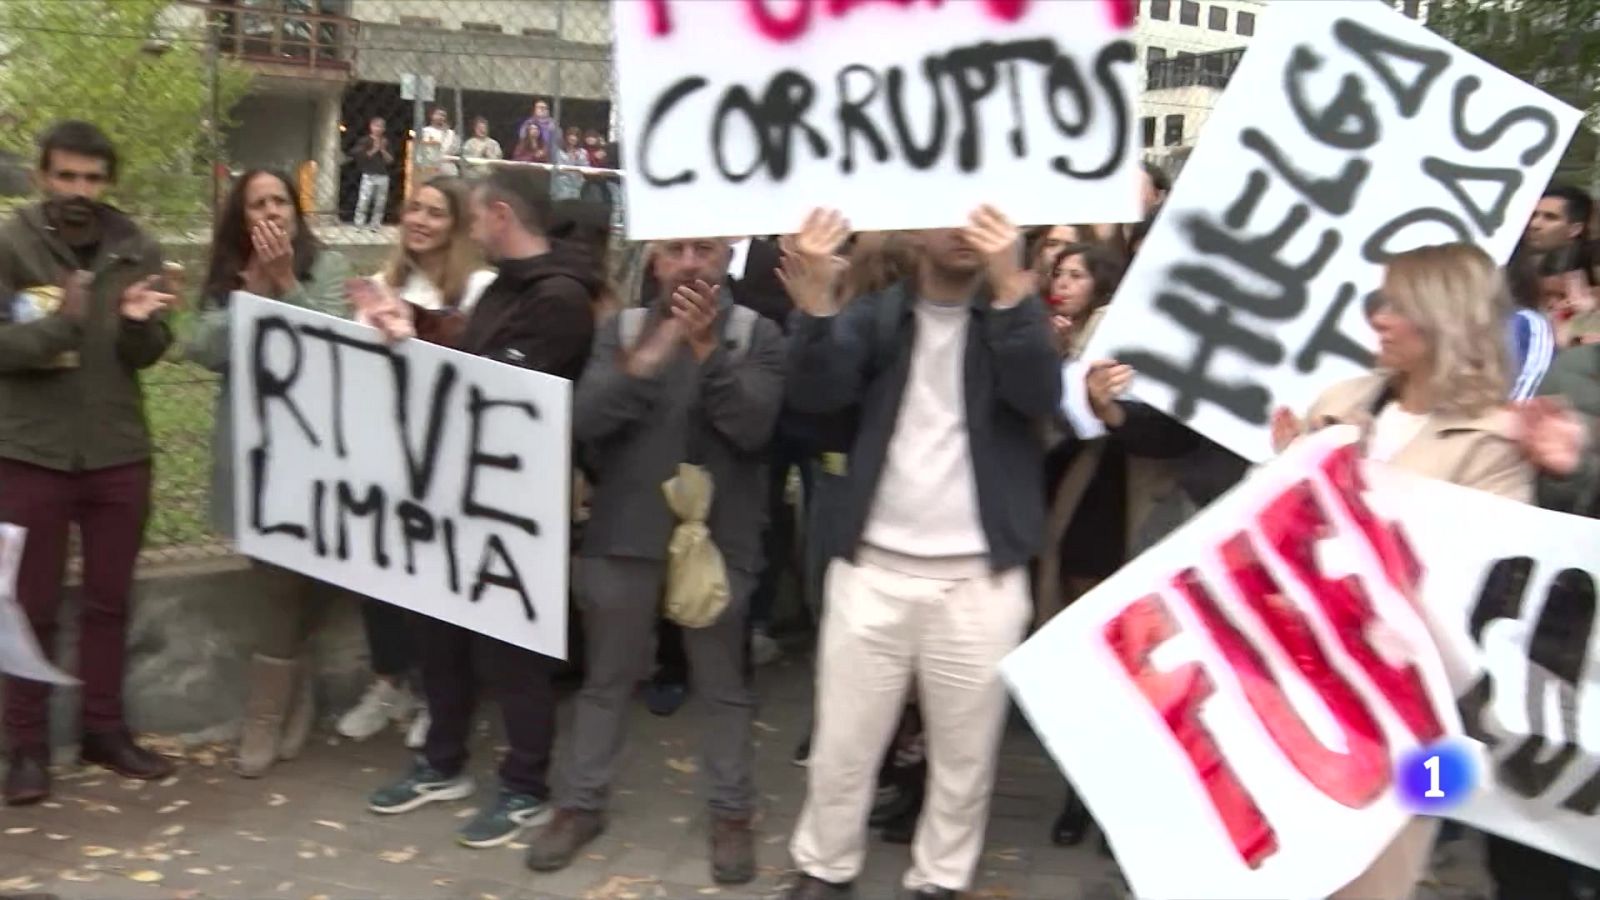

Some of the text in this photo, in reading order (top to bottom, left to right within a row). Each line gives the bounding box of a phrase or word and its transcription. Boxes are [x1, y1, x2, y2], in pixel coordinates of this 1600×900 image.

[637, 37, 1135, 188] CORRUPTOS
[1110, 16, 1453, 426] HUELGA
[251, 315, 541, 537] RTVE
[249, 445, 538, 622] LIMPIA
